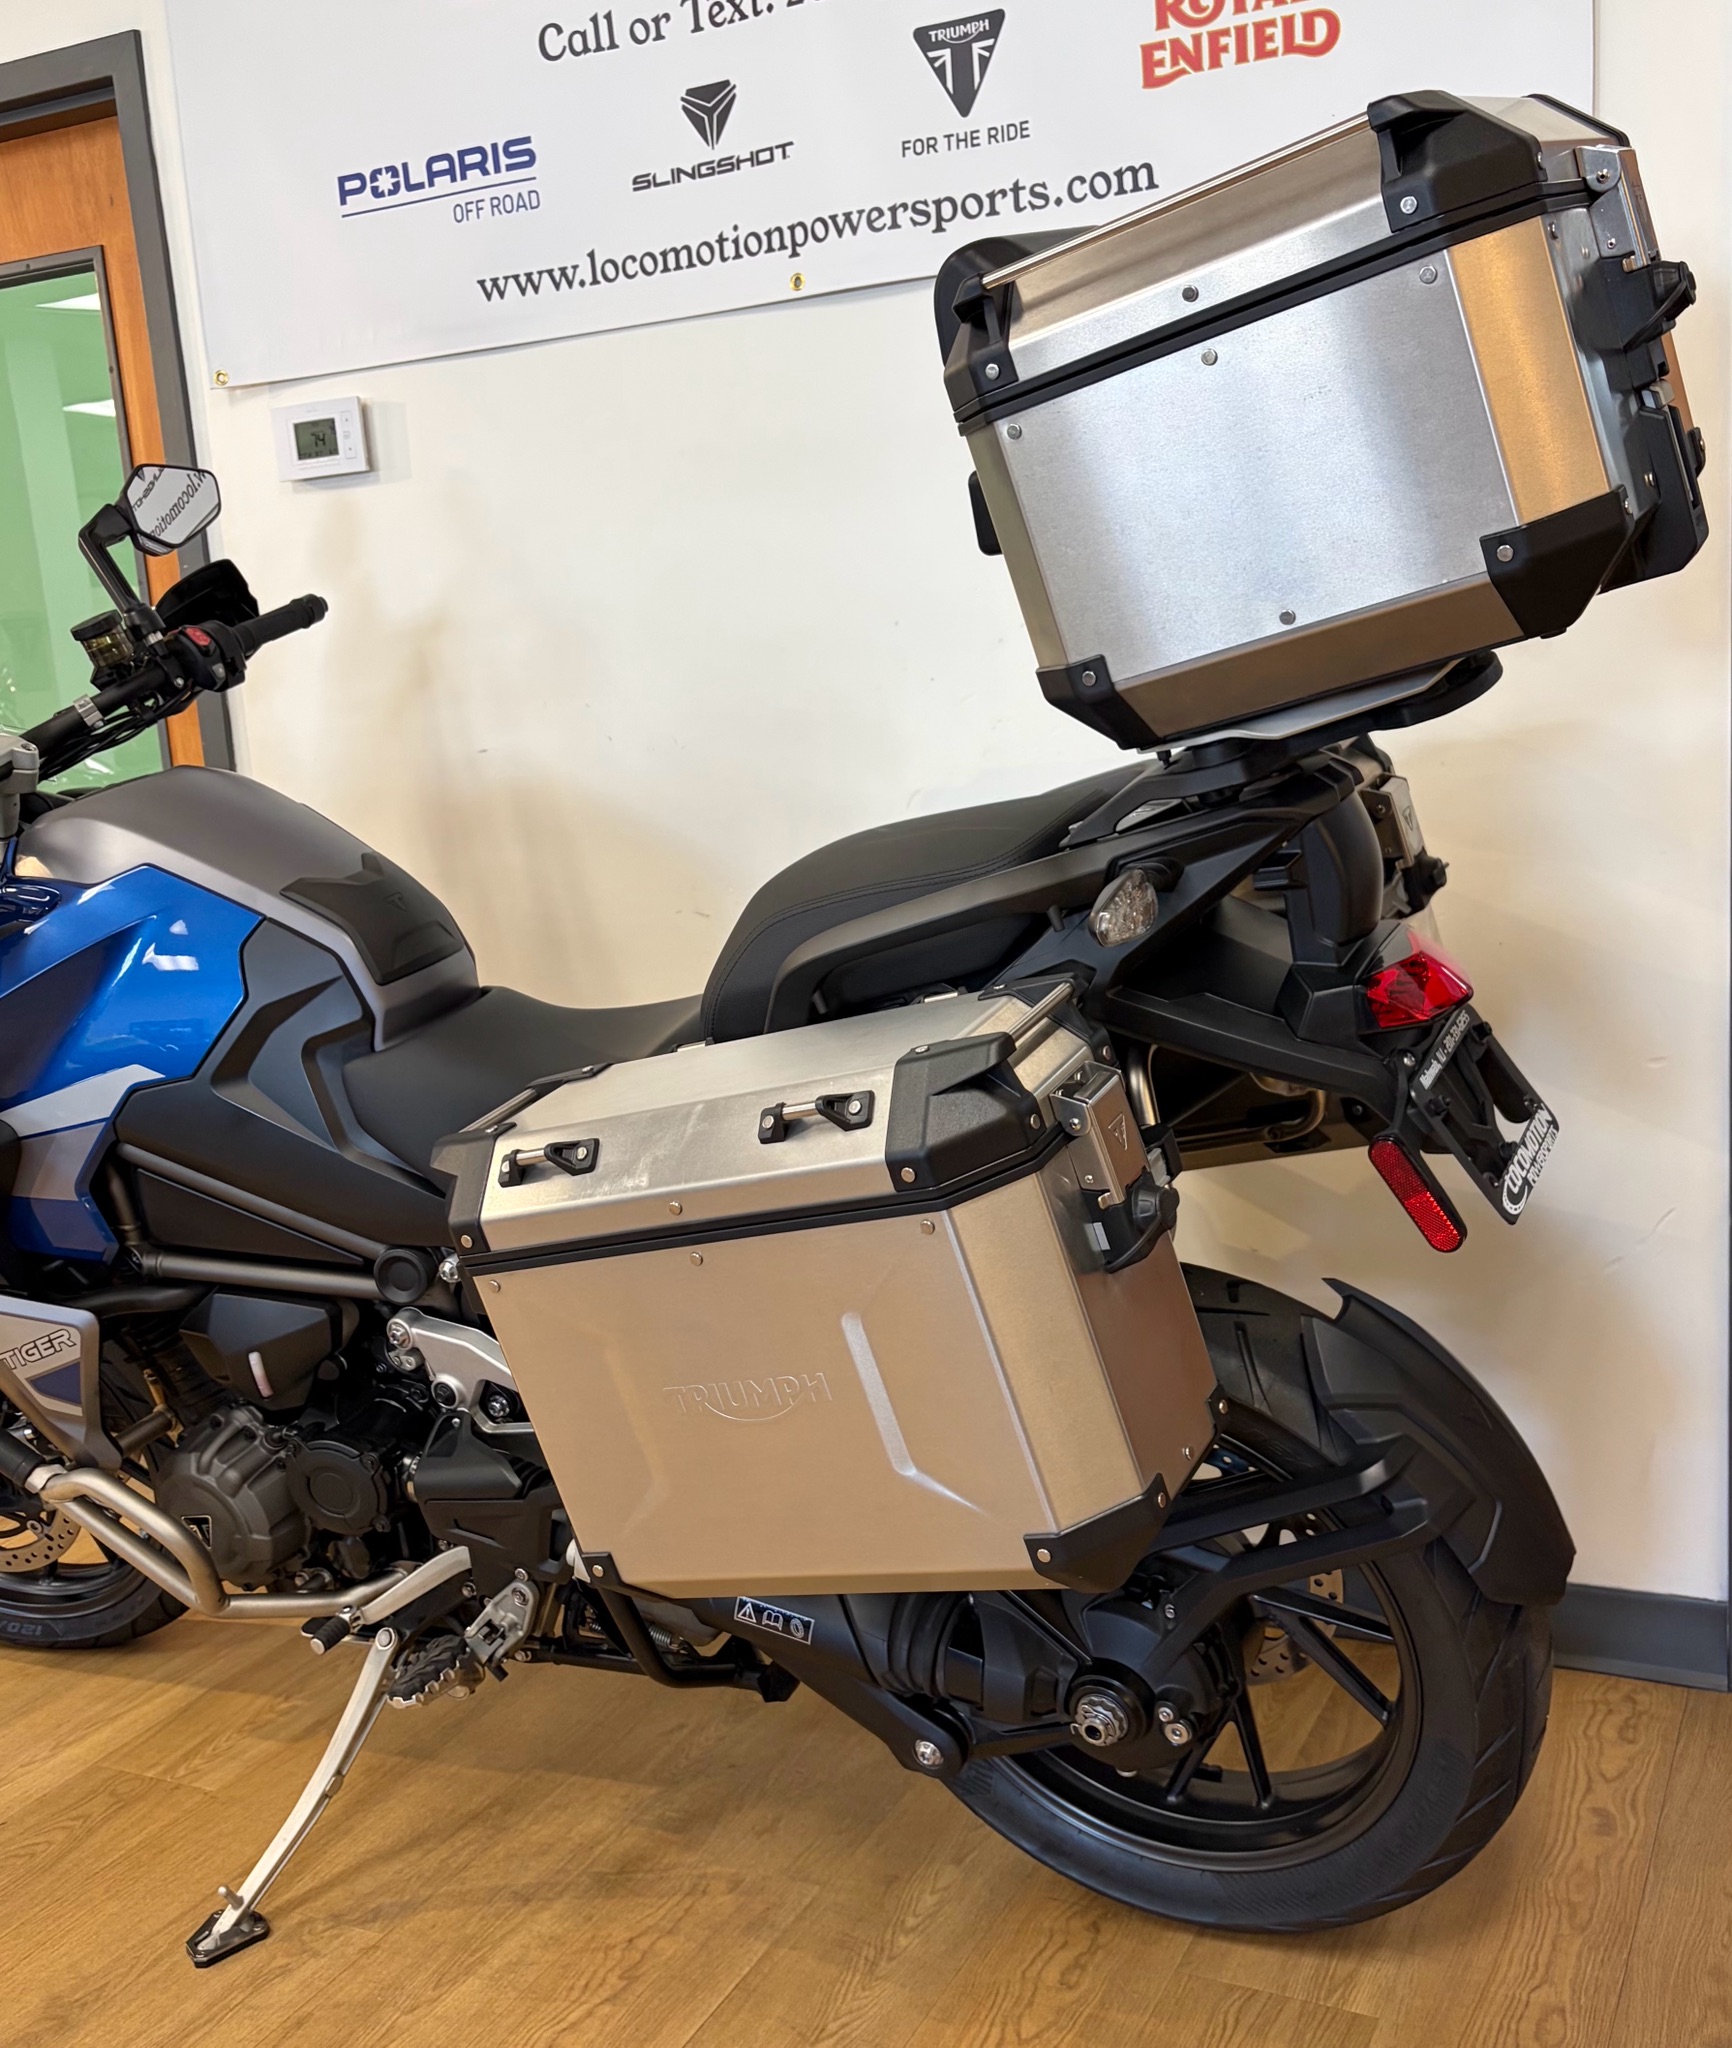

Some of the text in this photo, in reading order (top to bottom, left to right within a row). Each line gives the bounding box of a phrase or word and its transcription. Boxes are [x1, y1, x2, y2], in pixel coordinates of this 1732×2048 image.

[538, 10, 620, 62] Call
[628, 10, 672, 46] or
[927, 18, 991, 43] TRIUMPH
[1139, 8, 1341, 90] ENFIELD
[901, 120, 1031, 158] FOR THE RIDE
[336, 135, 538, 206] POLARIS
[632, 141, 795, 192] SLINGSHOT
[452, 189, 541, 223] OFF ROAD
[476, 161, 1160, 302] www.locomotionpowersports.com
[310, 432, 327, 448] 74
[1504, 1102, 1553, 1194] LOCOMOTION
[1526, 1124, 1559, 1187] POWERSPORTS
[0, 1328, 77, 1370] TIGER
[662, 1372, 833, 1420] TRIUMPH
